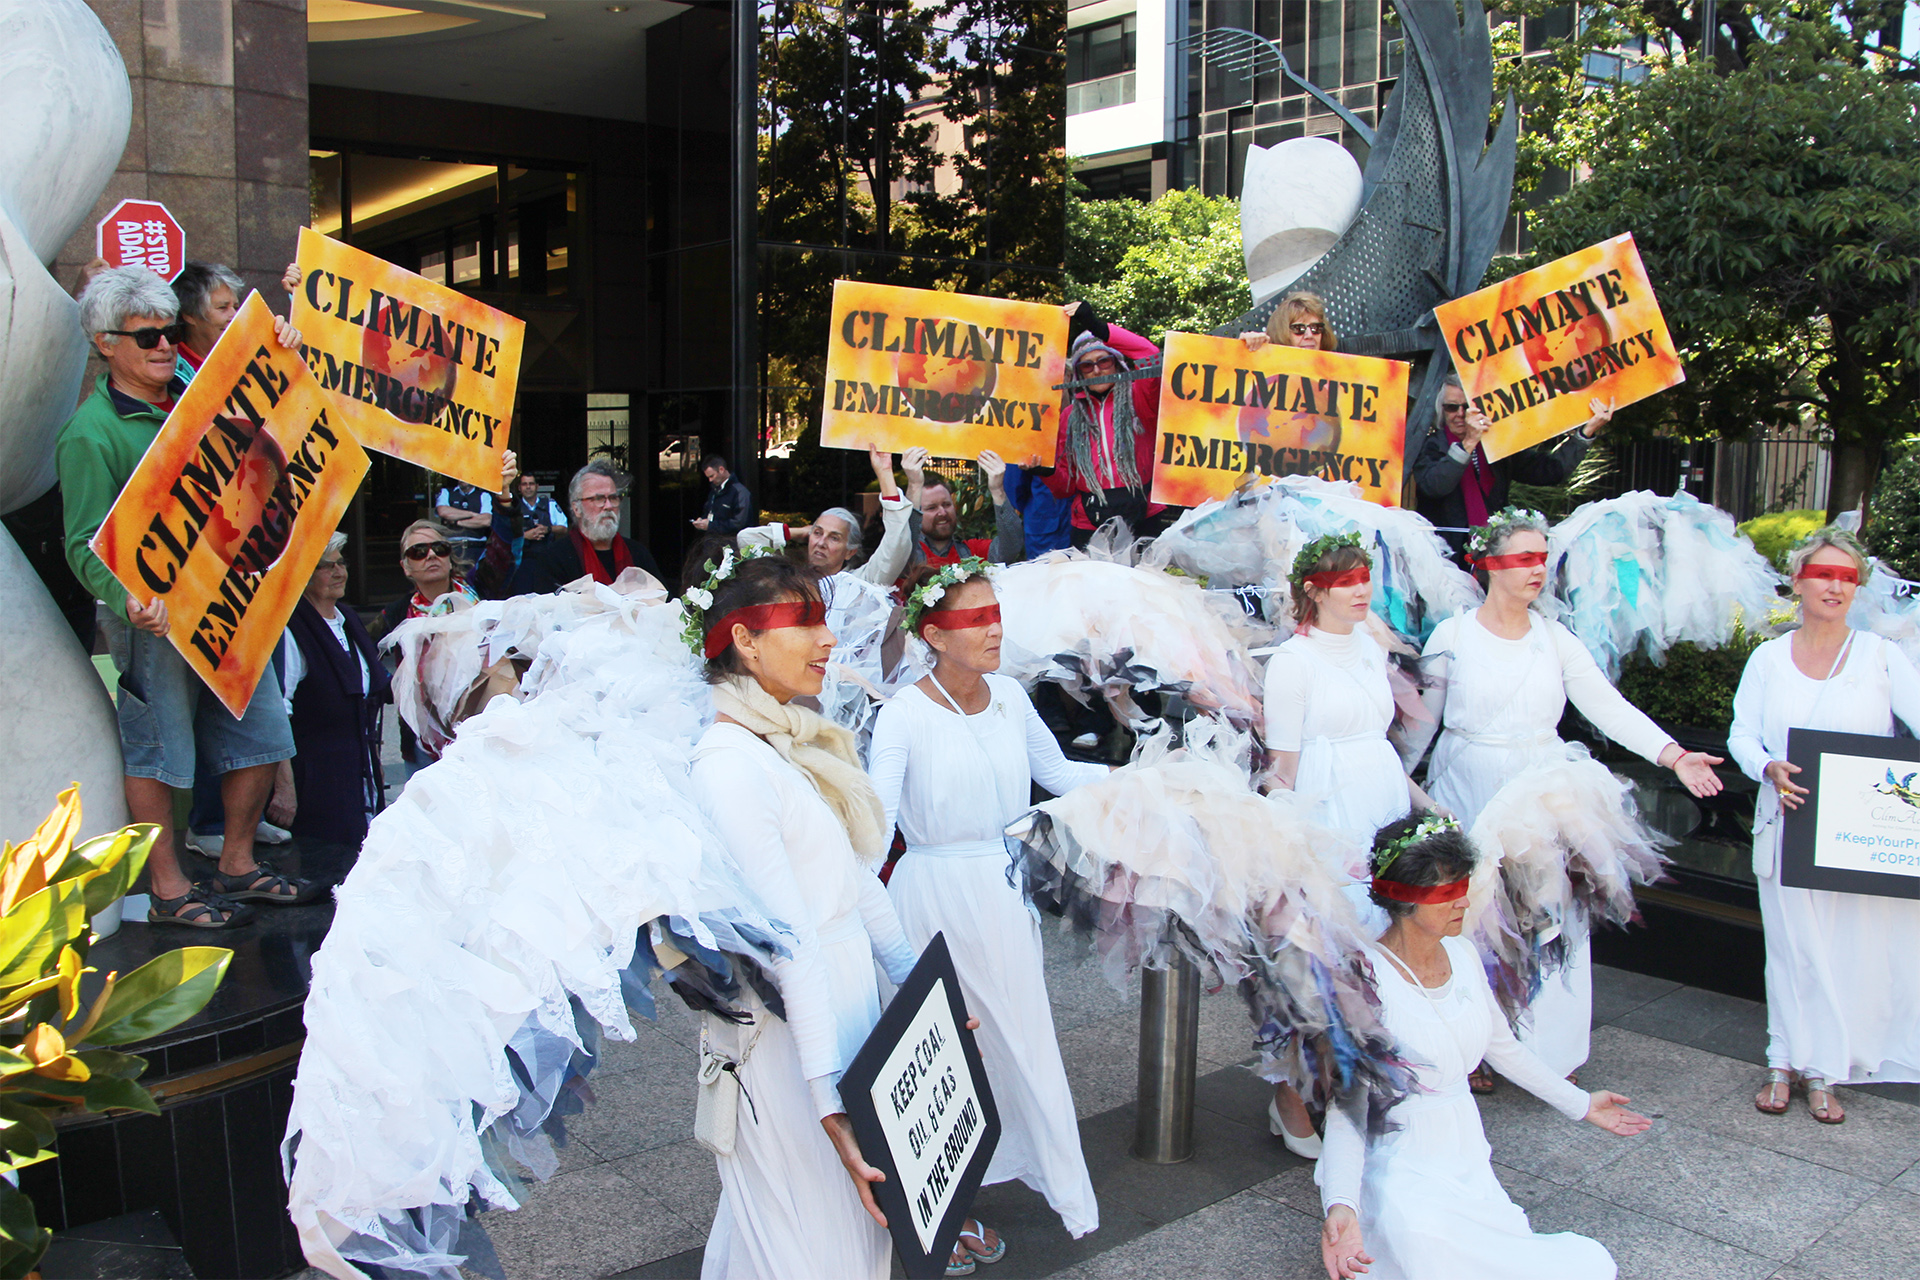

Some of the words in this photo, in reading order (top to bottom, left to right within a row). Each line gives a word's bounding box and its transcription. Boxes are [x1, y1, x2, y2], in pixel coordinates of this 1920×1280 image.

[144, 220, 170, 275] #STOP
[306, 268, 500, 379] CLIMATE
[841, 310, 1044, 370] CLIMATE
[1454, 269, 1629, 365] CLIMATE
[300, 344, 502, 448] EMERGENCY
[832, 379, 1050, 432] EMERGENCY
[1170, 362, 1379, 423] CLIMATE
[1472, 329, 1657, 424] EMERGENCY
[135, 345, 290, 595] CLIMATE
[1160, 432, 1389, 488] EMERGENCY
[190, 408, 340, 672] EMERGENCY
[1835, 831, 1920, 849] #KeepYourPr
[890, 1061, 919, 1121] KEEP
[915, 1022, 947, 1078] COAL
[932, 1065, 957, 1117] GAS
[908, 1118, 932, 1160] OIL
[927, 1103, 939, 1133] &
[916, 1187, 933, 1229] IN
[926, 1153, 950, 1206] THE
[943, 1096, 978, 1173] GROUND
